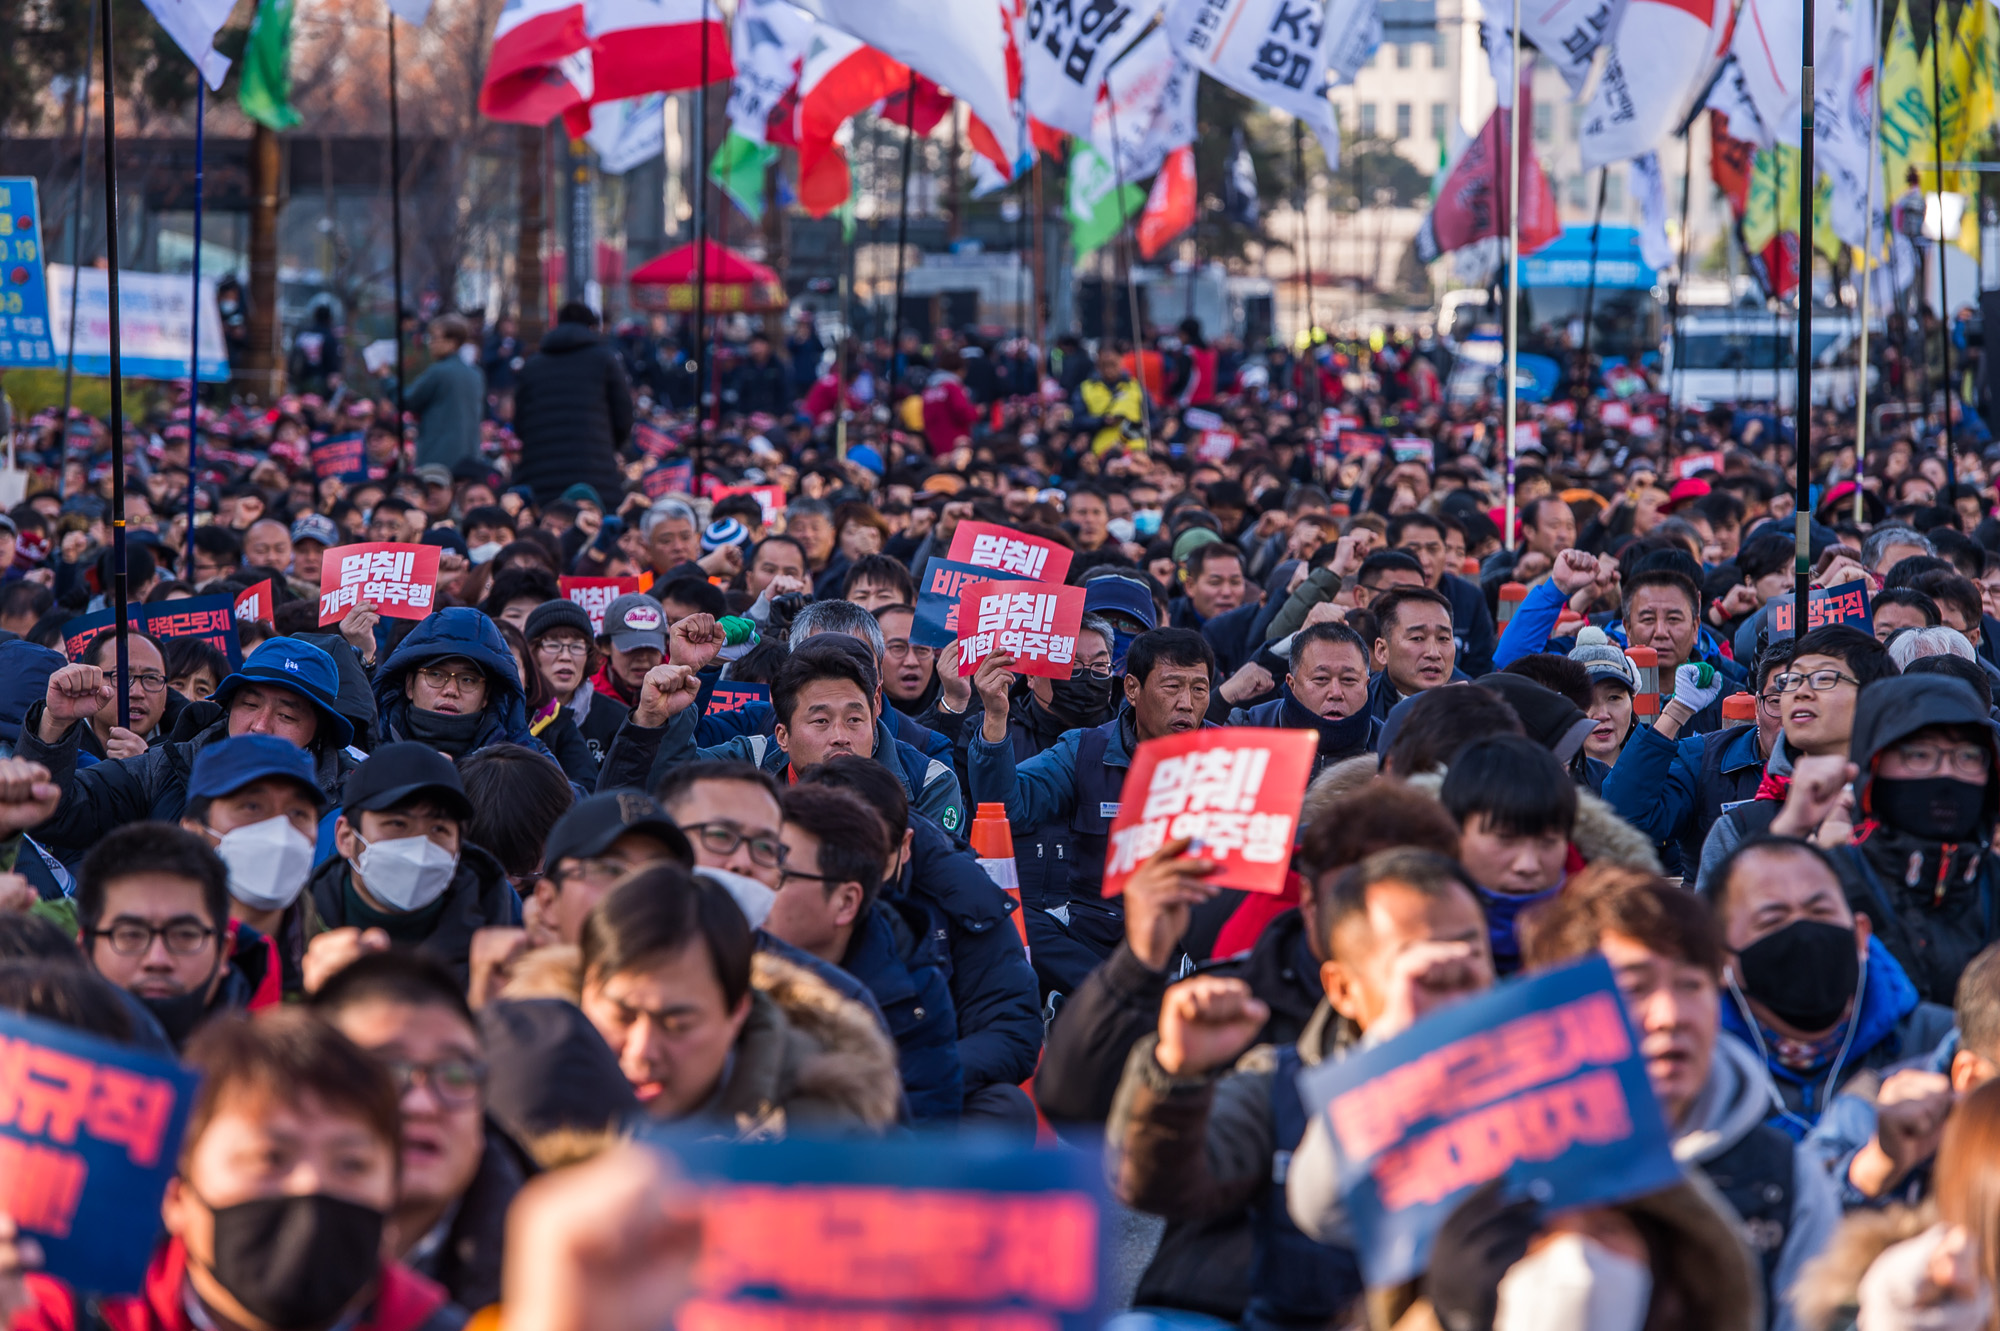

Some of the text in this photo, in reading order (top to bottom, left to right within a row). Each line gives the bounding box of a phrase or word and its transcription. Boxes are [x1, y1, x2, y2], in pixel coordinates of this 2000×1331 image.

[340, 551, 414, 587] 멈춰!
[970, 534, 1049, 579] 멈춰!
[321, 582, 432, 618] 개혁 역주행
[977, 592, 1057, 633] 멈춰!
[147, 608, 231, 640] 탄력근로제
[959, 630, 1075, 666] 개혁 역주행
[704, 690, 760, 716] 규직
[1141, 747, 1271, 820] 멈춰!
[1106, 812, 1292, 877] 개혁 역주행
